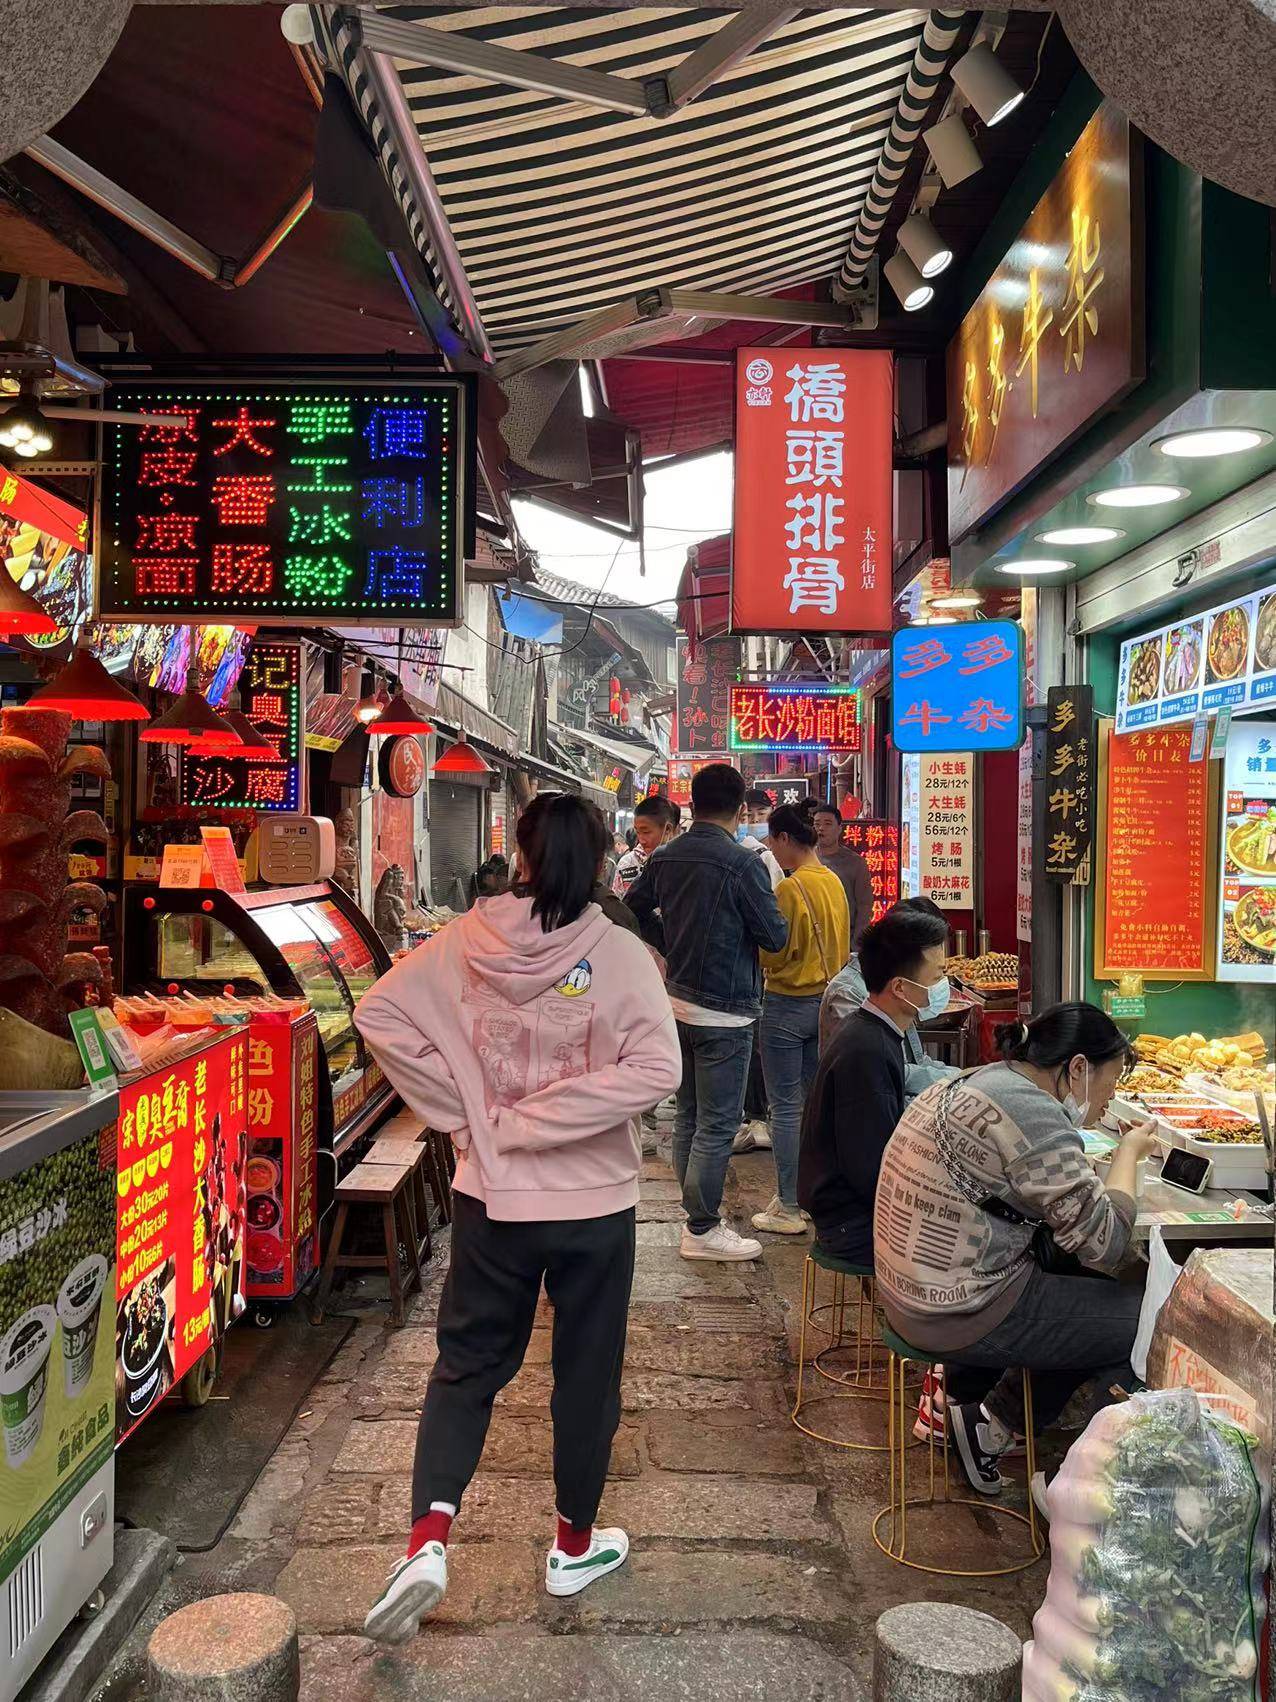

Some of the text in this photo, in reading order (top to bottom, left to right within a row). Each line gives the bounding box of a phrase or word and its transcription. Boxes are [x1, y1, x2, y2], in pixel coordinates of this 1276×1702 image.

[210, 406, 276, 595] 大香肠
[285, 405, 354, 597] 手工冰粉
[362, 406, 431, 598] 便利店
[783, 363, 847, 615] 橋頭排骨
[860, 526, 876, 590] 太平街店
[899, 633, 1015, 679] 多多
[736, 694, 857, 743] 老长沙粉面馆
[898, 696, 1014, 737] 牛杂
[929, 762, 966, 775] 小生蚝
[1047, 699, 1078, 864] 多多牛杂
[925, 778, 969, 789] 28元/12个
[1075, 737, 1089, 833] 老街必吃小吃
[929, 796, 966, 810] 大生蚝
[925, 825, 969, 836] 56元/12个
[927, 813, 966, 823] 28元/6个
[931, 842, 962, 856] 烤肠
[931, 857, 962, 868] 5元/1根
[923, 876, 970, 889] 酸奶大麻花
[931, 891, 961, 901] 6元/1根
[913, 1194, 936, 1218] keep
[896, 1276, 927, 1300] BORING
[929, 1284, 968, 1303] ROOM
